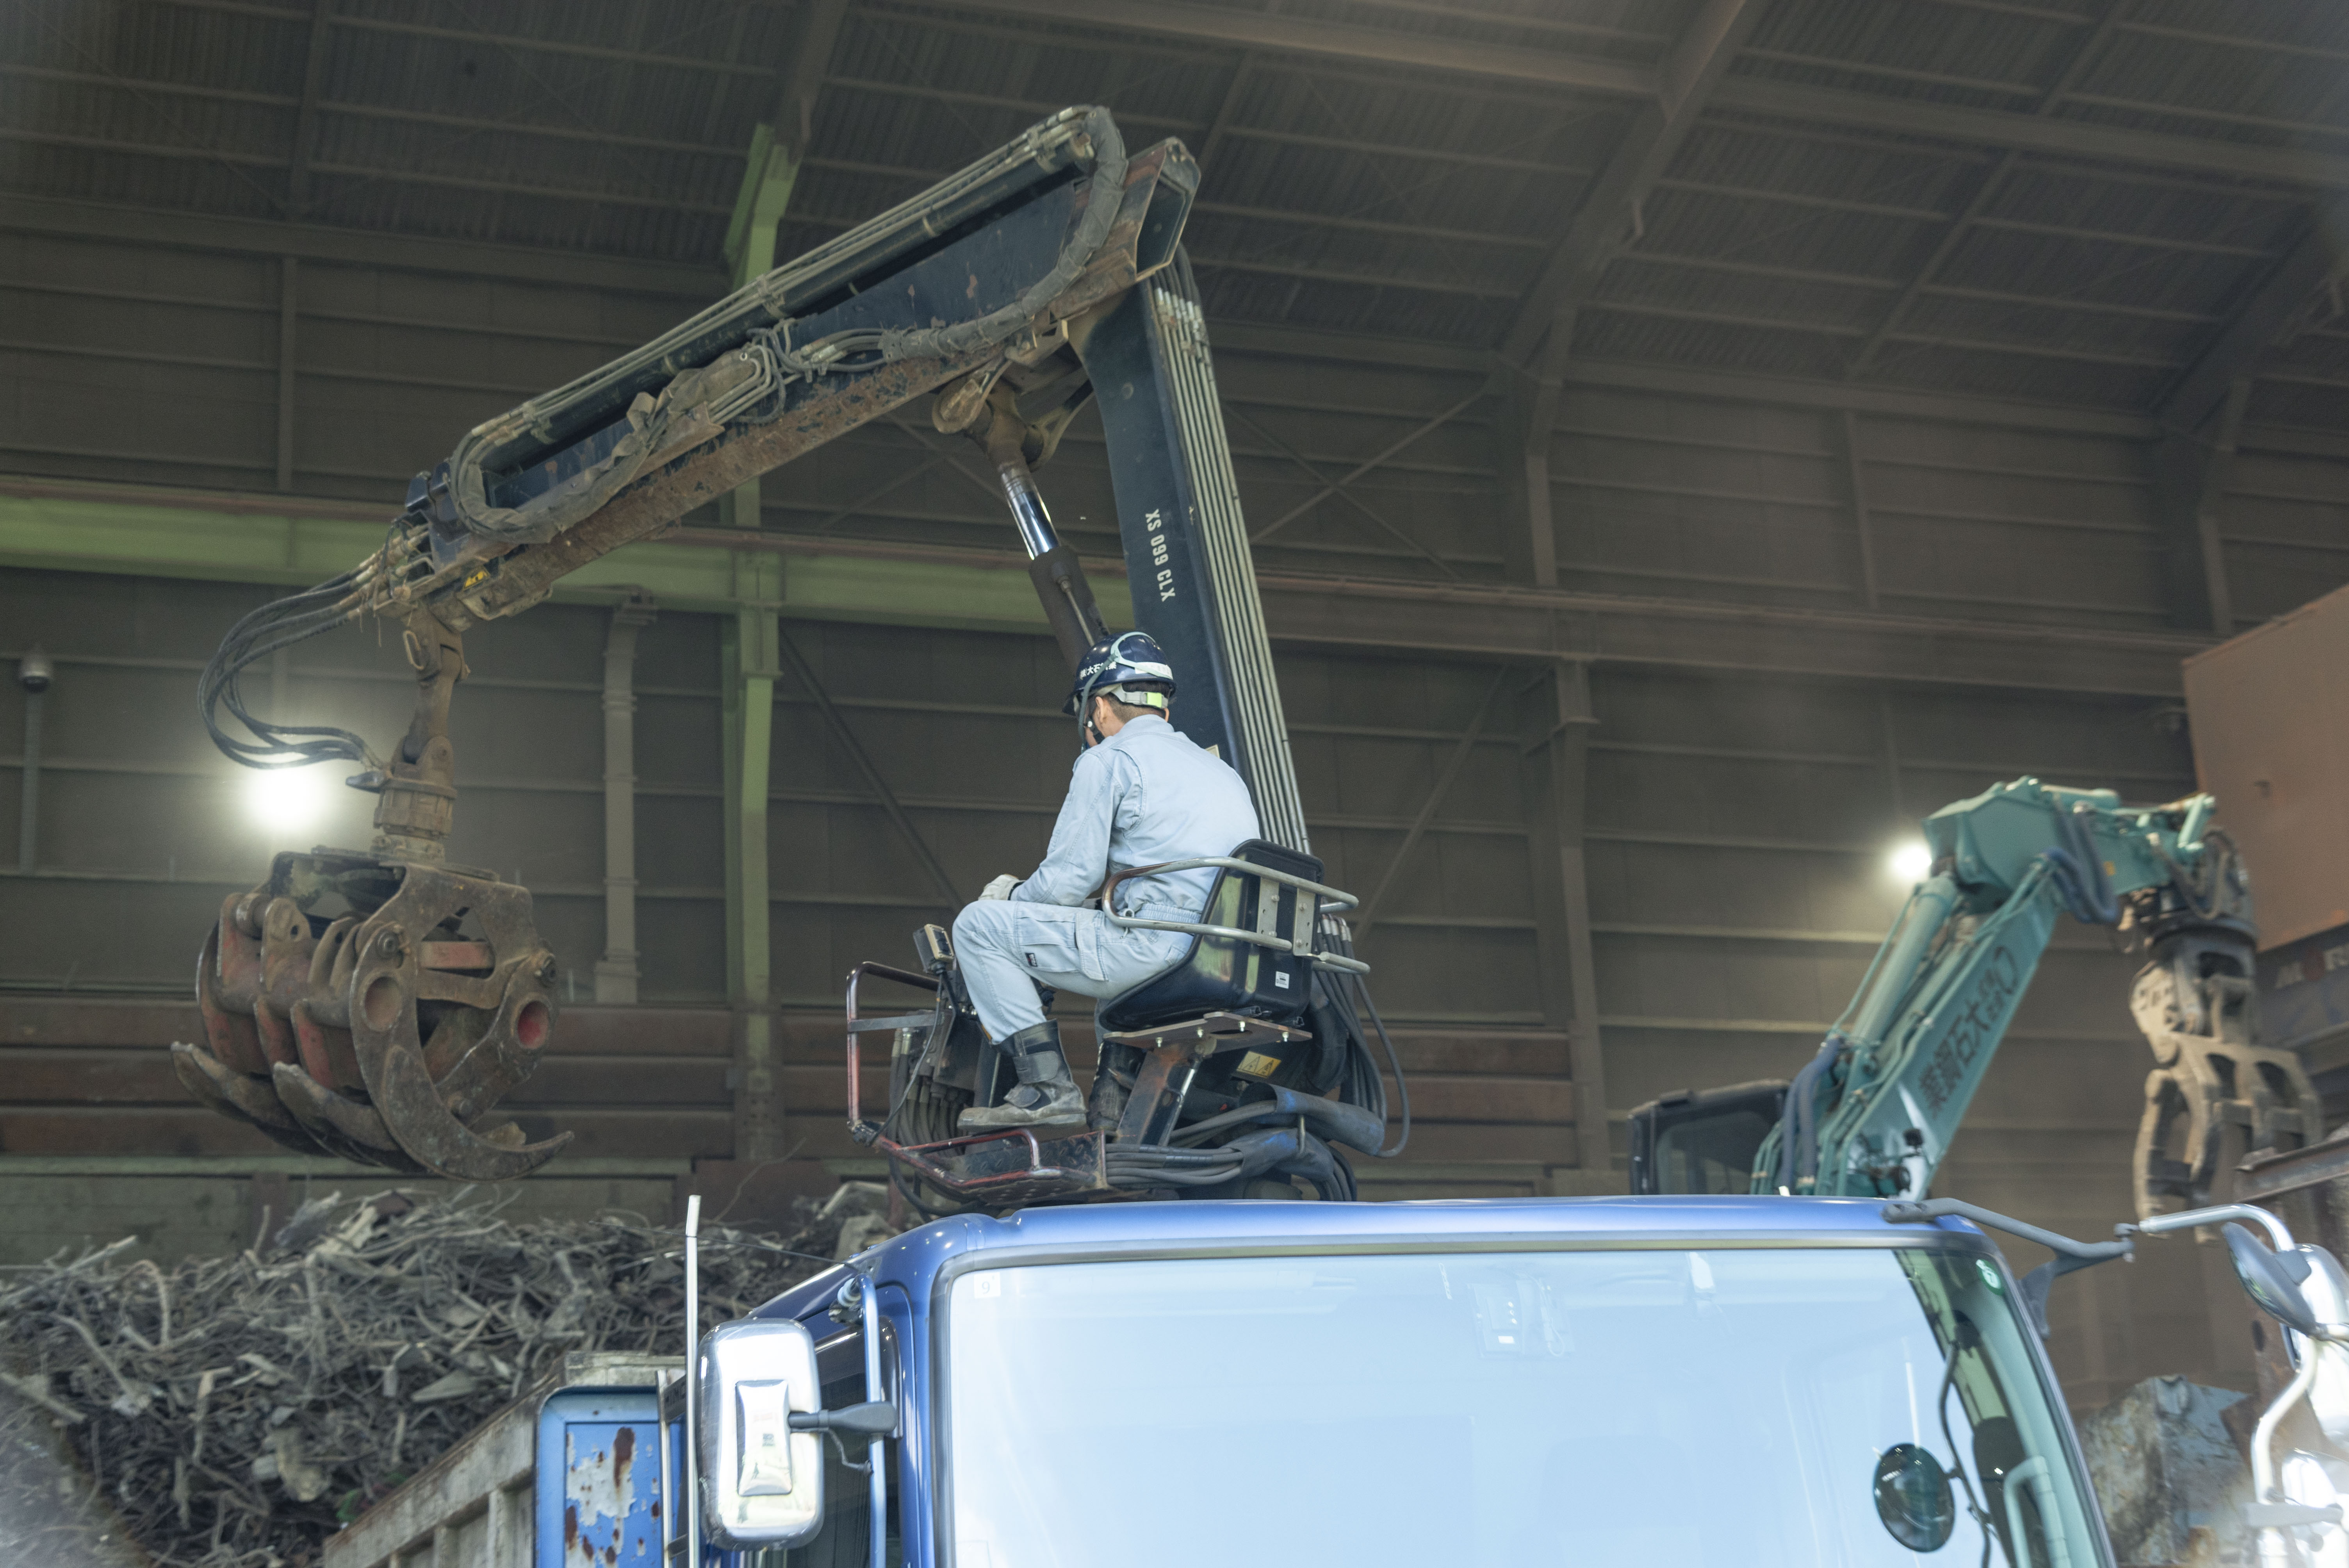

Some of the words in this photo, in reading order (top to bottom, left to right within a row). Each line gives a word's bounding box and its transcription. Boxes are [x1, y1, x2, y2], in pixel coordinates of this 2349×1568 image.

[1145, 509, 1162, 531] XS
[1151, 534, 1169, 566] 099
[1157, 569, 1175, 602] CLX
